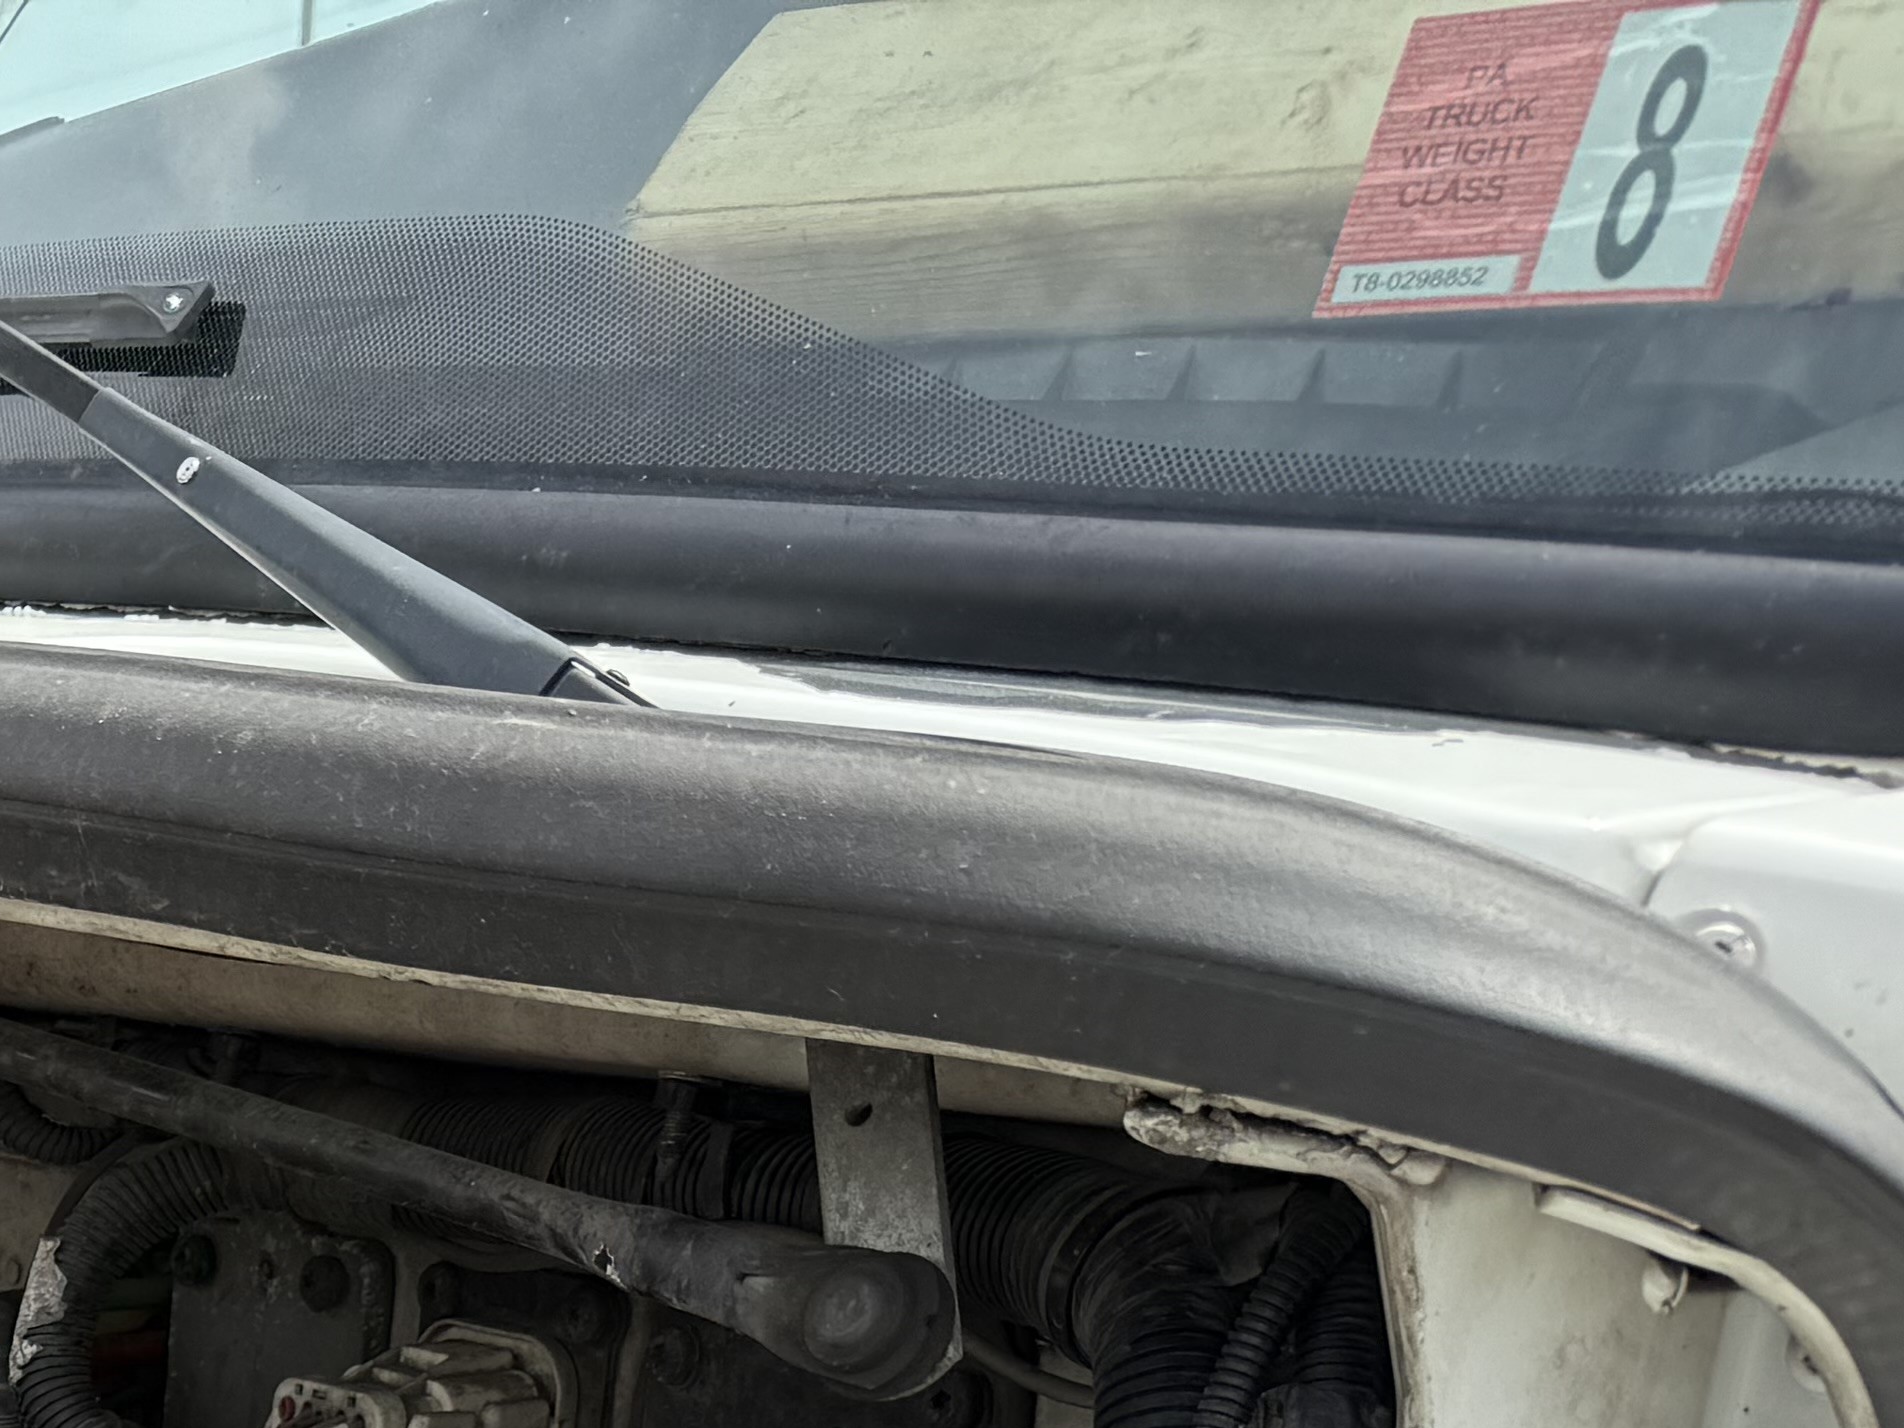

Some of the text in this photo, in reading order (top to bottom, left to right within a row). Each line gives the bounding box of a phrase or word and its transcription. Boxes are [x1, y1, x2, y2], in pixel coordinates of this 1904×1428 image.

[1466, 62, 1507, 89] PA
[1423, 96, 1539, 130] TRUCK
[1401, 135, 1537, 169] WEIGHT
[1595, 43, 1708, 279] 8
[1398, 174, 1508, 208] CLASS
